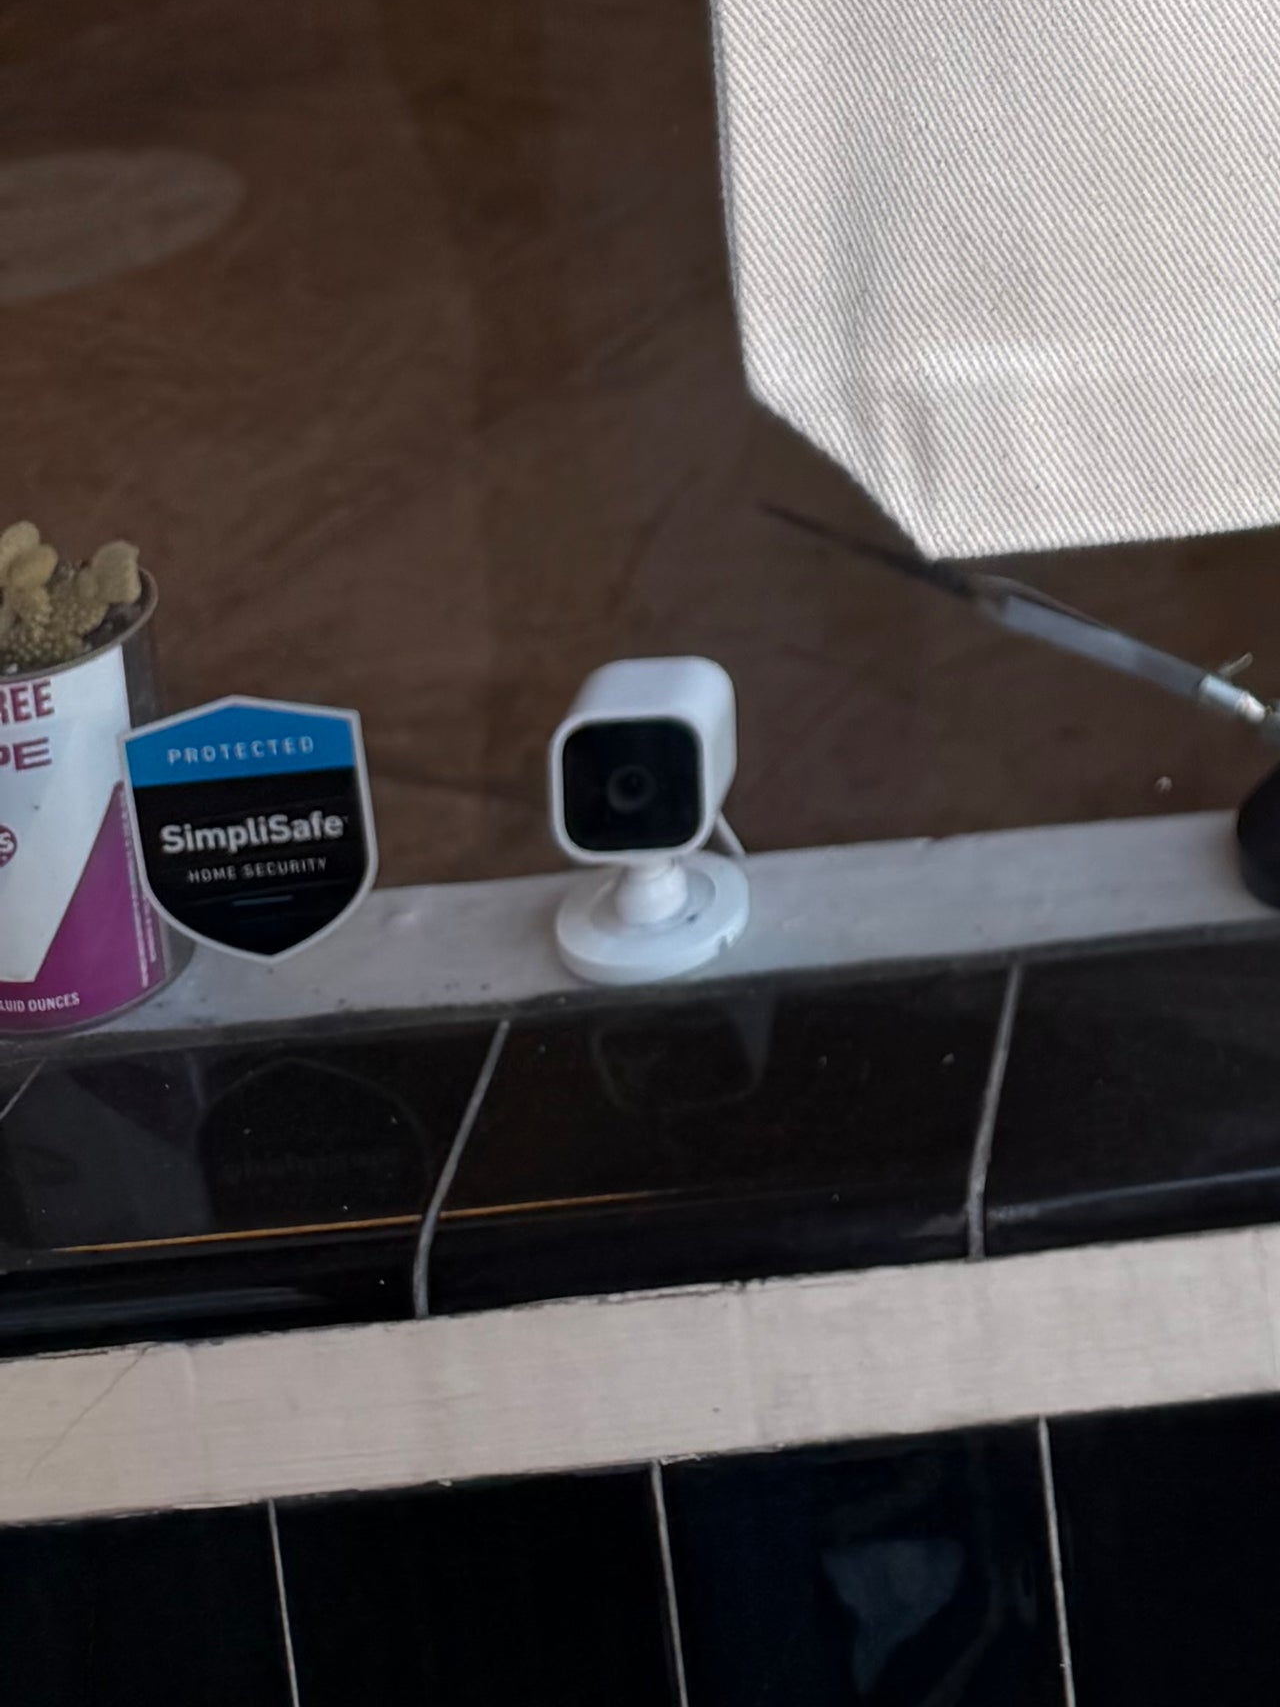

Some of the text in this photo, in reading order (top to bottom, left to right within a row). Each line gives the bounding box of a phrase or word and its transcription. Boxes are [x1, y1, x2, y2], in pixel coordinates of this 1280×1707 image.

[168, 735, 315, 765] PROTECTED
[160, 810, 345, 855] SimpliSafe
[188, 855, 328, 884] HOME SECURITY
[27, 991, 80, 1013] OUNCES
